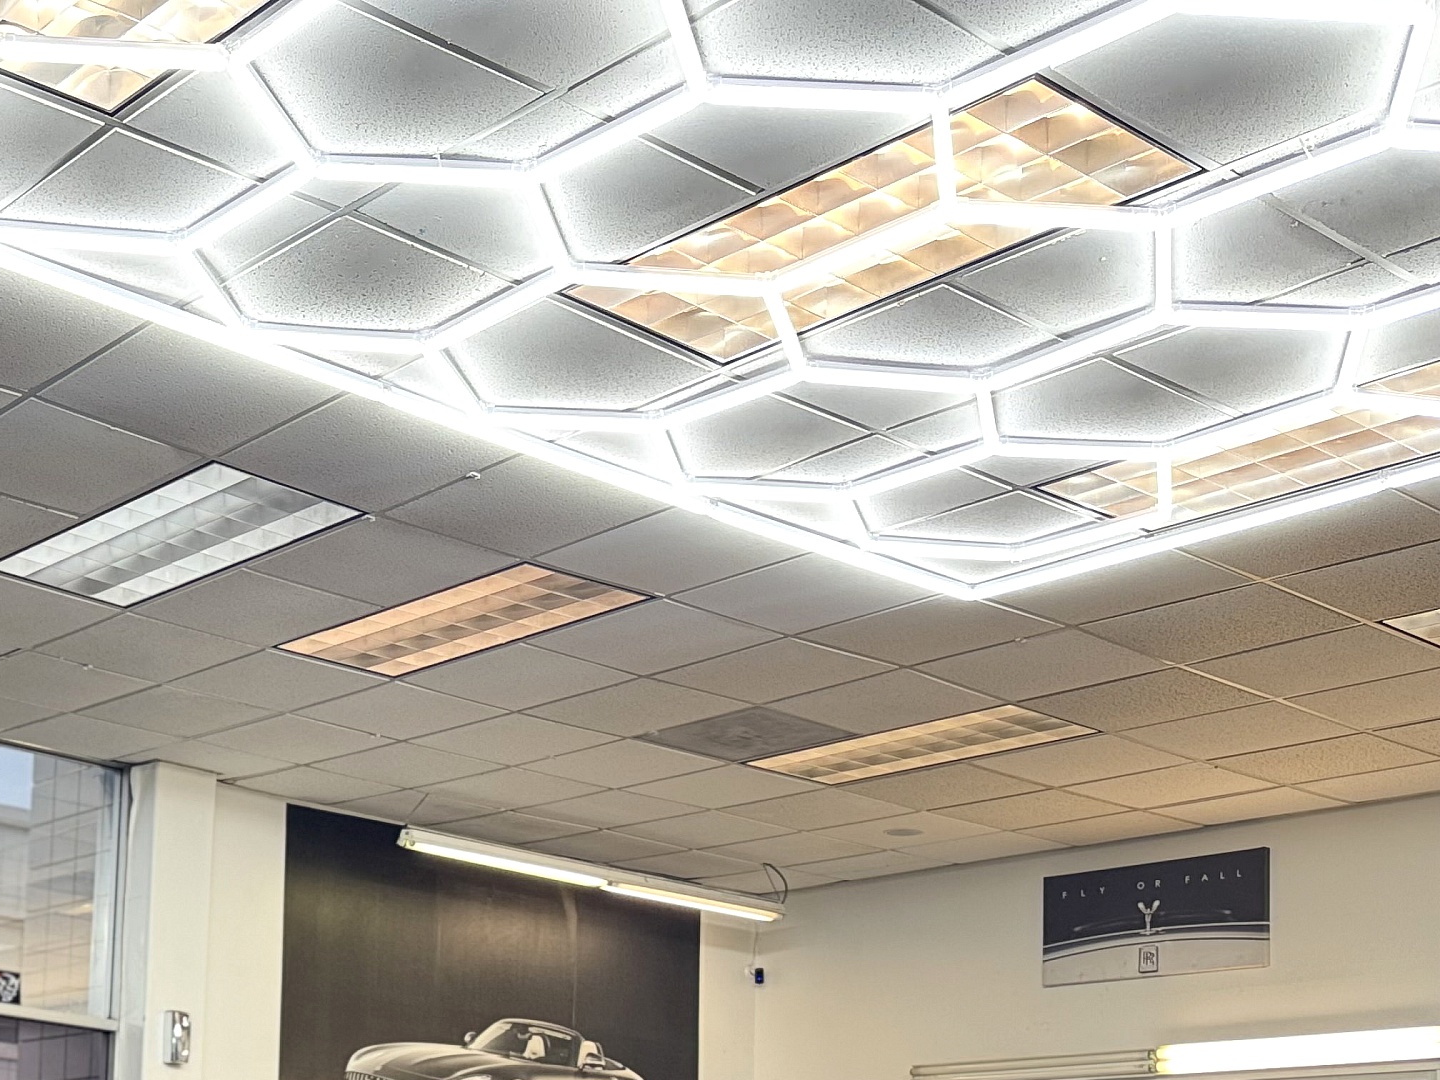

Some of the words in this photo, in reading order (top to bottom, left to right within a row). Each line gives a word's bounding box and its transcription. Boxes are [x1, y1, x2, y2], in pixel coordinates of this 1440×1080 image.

[1062, 886, 1105, 899] FLY
[1137, 880, 1161, 890] OR
[1185, 869, 1242, 884] FALL
